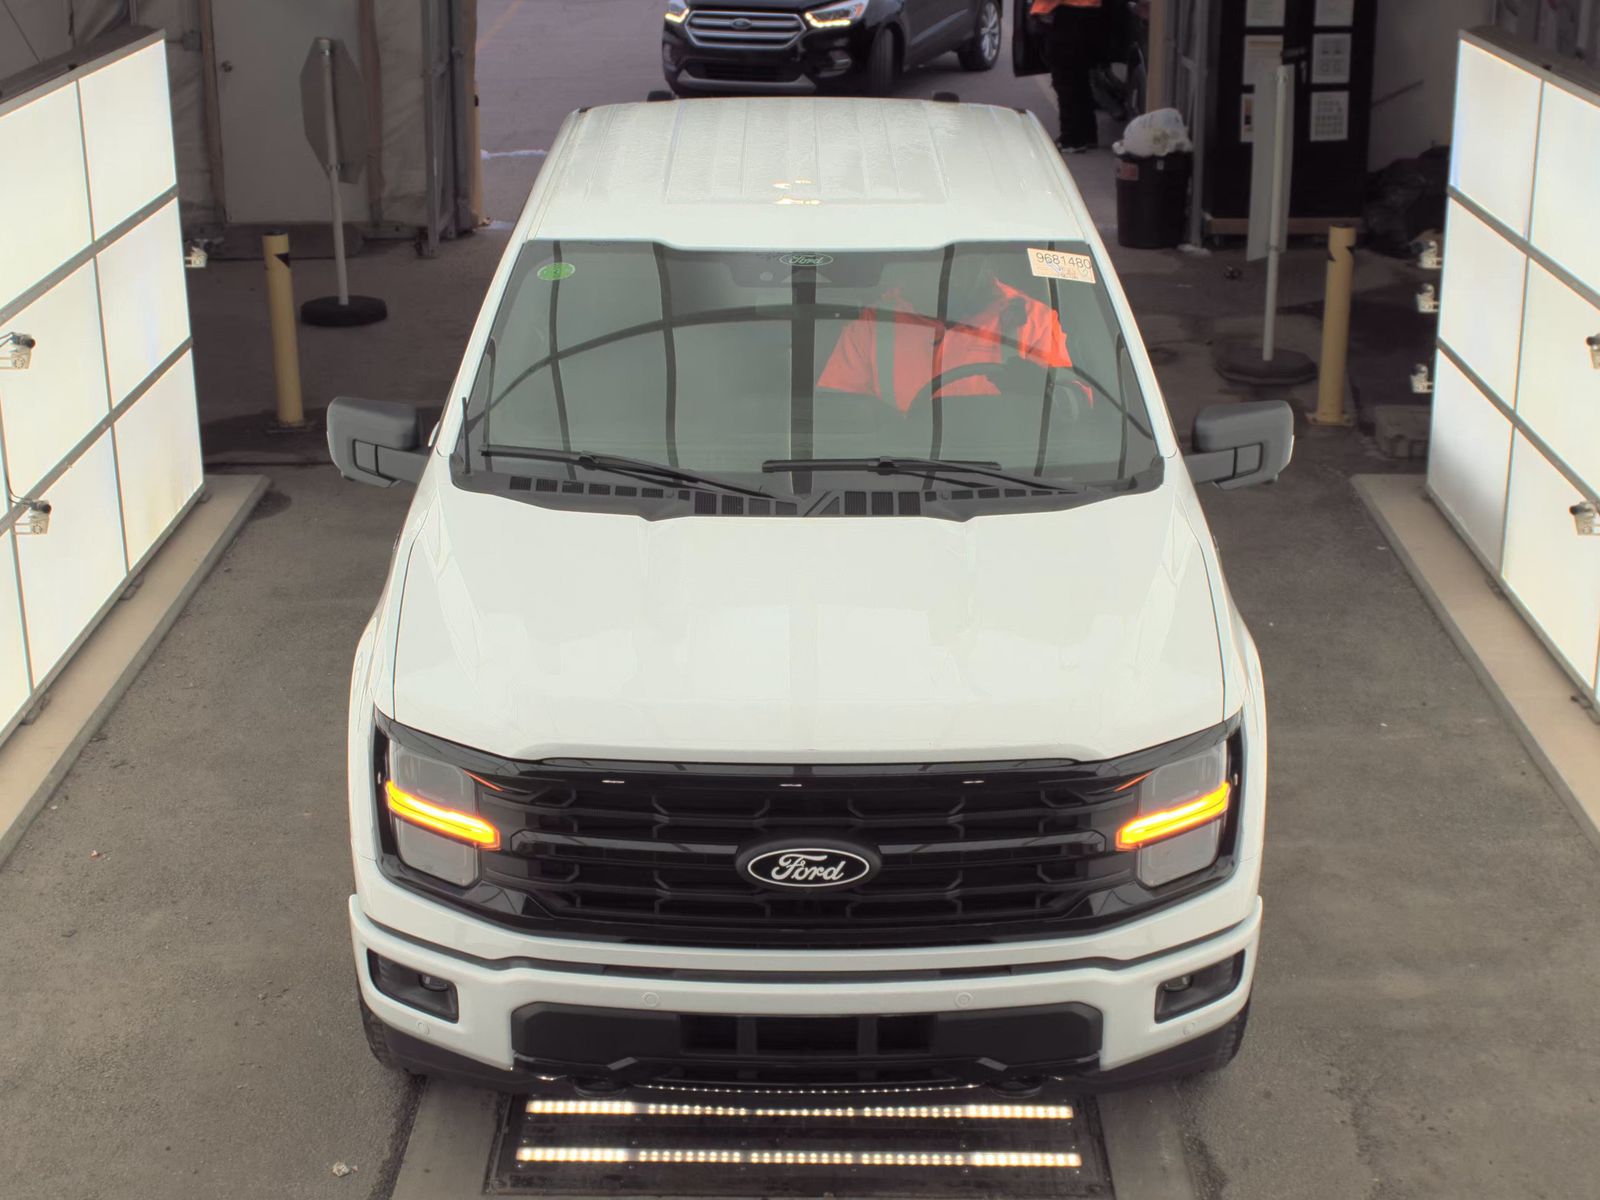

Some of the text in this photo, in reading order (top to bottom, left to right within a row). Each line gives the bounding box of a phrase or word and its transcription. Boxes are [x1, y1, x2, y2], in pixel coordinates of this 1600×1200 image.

[789, 254, 823, 264] Ford
[1036, 252, 1091, 269] 9681480
[771, 853, 846, 880] Ford
